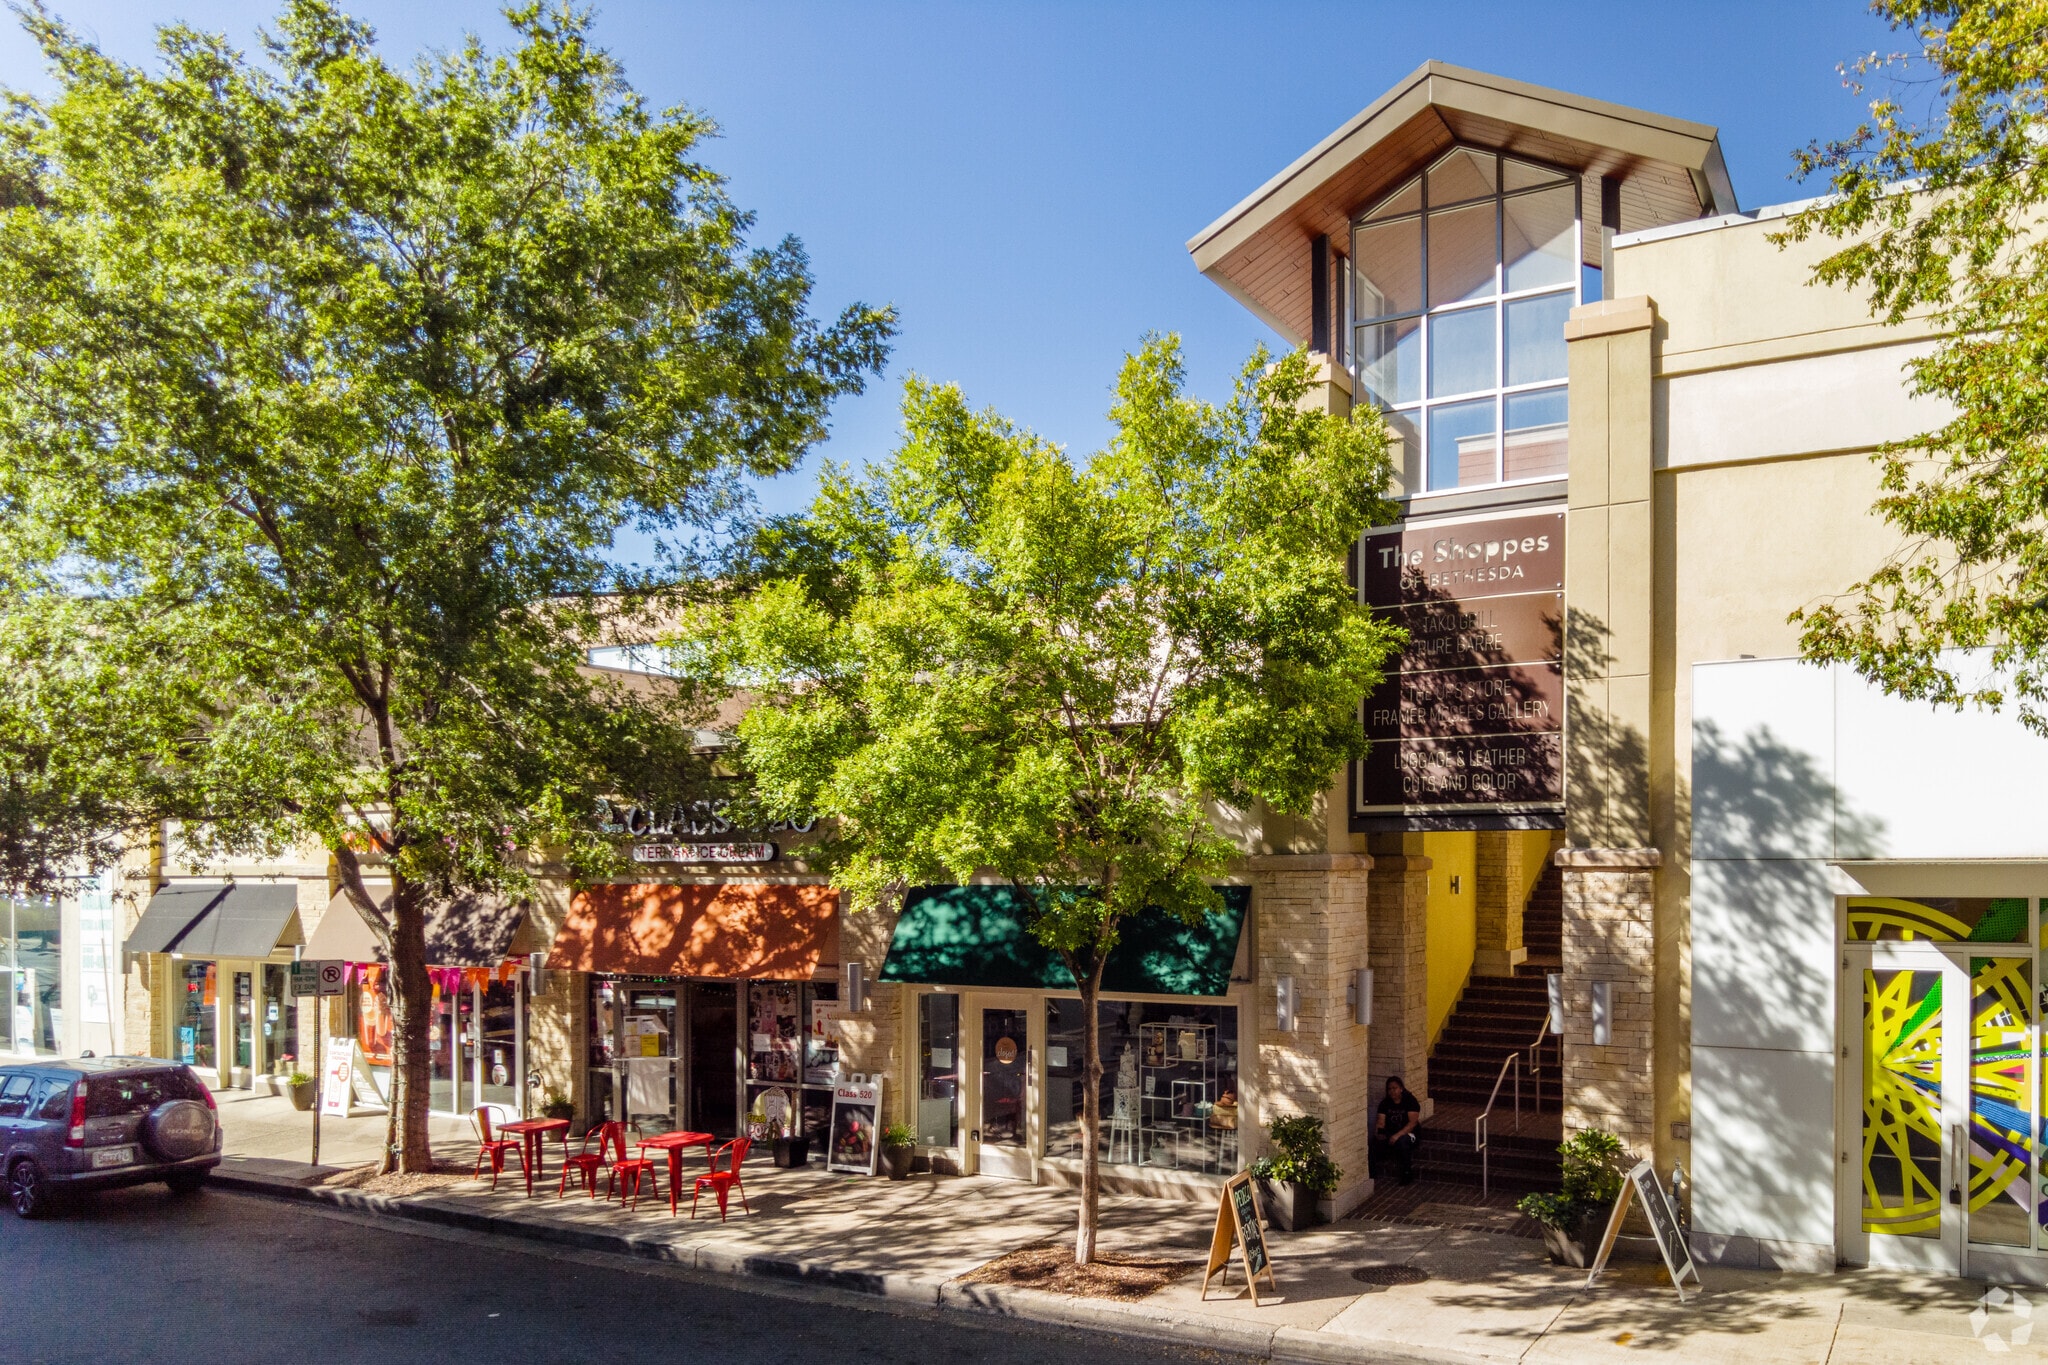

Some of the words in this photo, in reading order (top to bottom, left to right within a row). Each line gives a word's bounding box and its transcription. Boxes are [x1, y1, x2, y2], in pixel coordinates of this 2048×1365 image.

[1378, 545, 1423, 568] The
[1433, 535, 1550, 563] Shoppes
[1400, 576, 1421, 590] OF
[1430, 565, 1524, 587] BETHESDA
[1423, 614, 1455, 632] TAKO
[1460, 610, 1498, 630] GRILL
[1418, 637, 1452, 655] PURE
[1457, 633, 1503, 652] BARRE
[1408, 686, 1432, 702] THE
[1437, 683, 1463, 700] UPS
[1468, 679, 1512, 698] STORE
[1373, 707, 1427, 726] FRAMER
[1488, 700, 1550, 720] GALLERY
[1394, 751, 1452, 769] LUGGAGE
[1457, 750, 1465, 767] &
[1470, 748, 1526, 766] LEATHER
[1403, 776, 1436, 793] CUTS
[1440, 775, 1467, 791] AND
[1472, 773, 1516, 791] COLOR
[838, 1088, 857, 1099] Class
[860, 1090, 873, 1099] 520
[166, 1127, 204, 1135] HONDA
